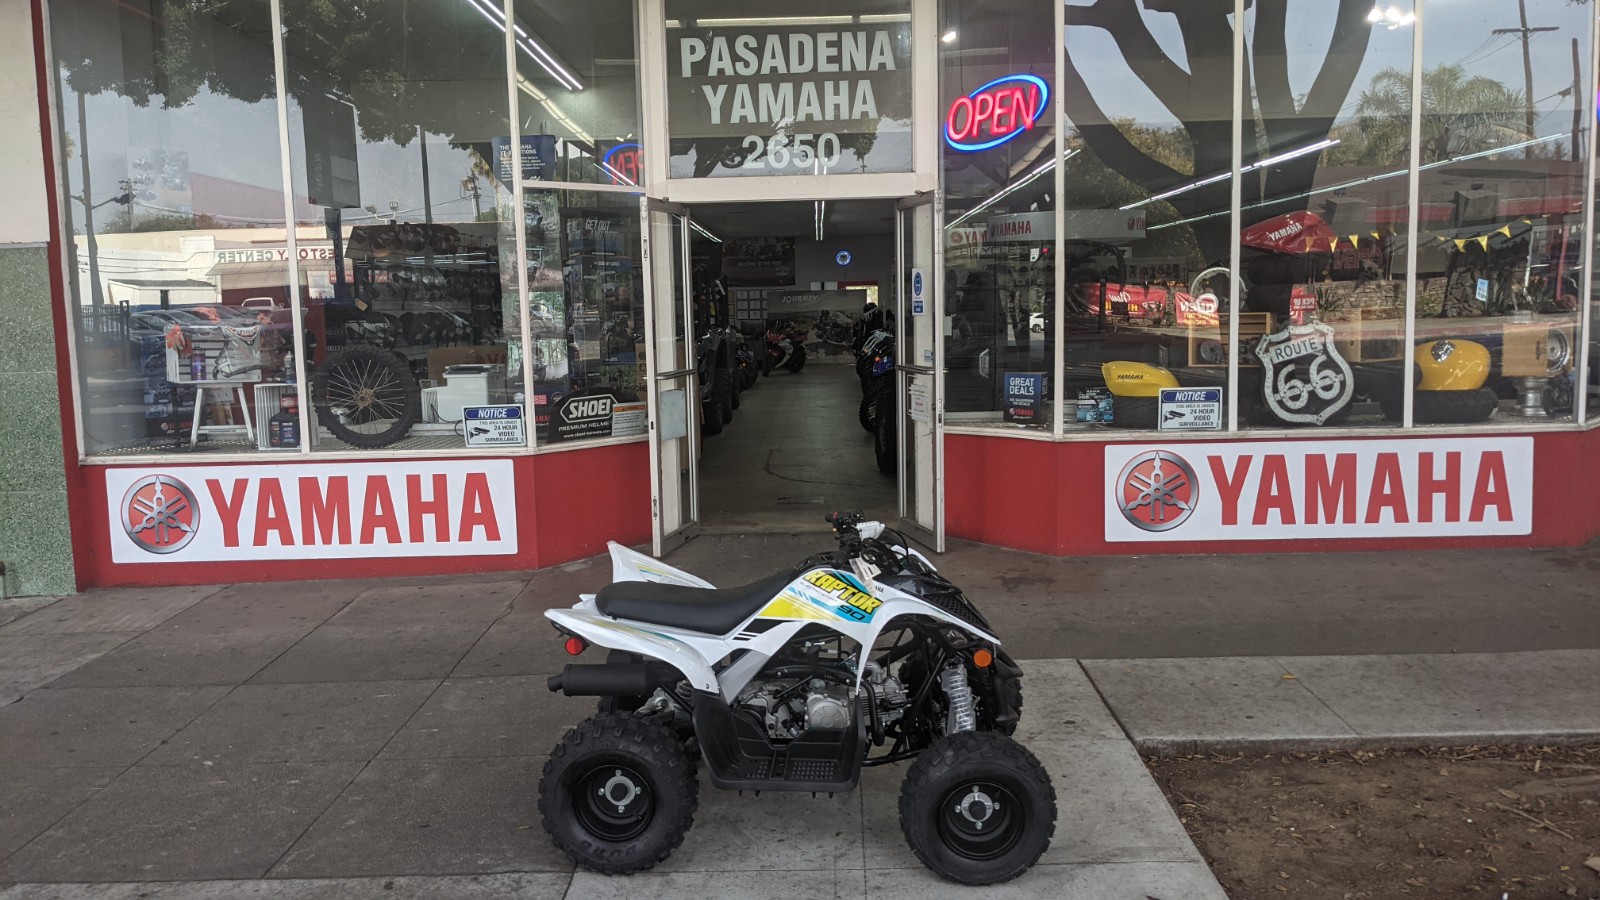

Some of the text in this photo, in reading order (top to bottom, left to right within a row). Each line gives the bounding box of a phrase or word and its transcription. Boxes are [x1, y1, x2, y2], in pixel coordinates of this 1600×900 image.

[680, 30, 896, 79] PASADENA
[701, 79, 879, 126] YAMAHA
[947, 84, 1038, 142] OPEN
[742, 132, 841, 170] 2650
[995, 220, 1032, 237] YAMAHA
[1268, 222, 1302, 241] YAMAHA
[782, 294, 819, 304] JOURNEY
[1274, 337, 1318, 361] ROUTE
[1009, 377, 1034, 387] GREAT
[1009, 386, 1034, 396] DEALS
[1277, 355, 1341, 410] 66
[1175, 391, 1206, 401] NOTICE
[478, 408, 508, 418] NOTICE
[568, 398, 611, 419] SHOEI
[558, 422, 588, 432] PREMIUM
[1207, 450, 1514, 526] YAMAHA
[204, 472, 502, 548] YAMAHA
[802, 571, 884, 615] RAPTOR
[837, 604, 866, 621] 90
